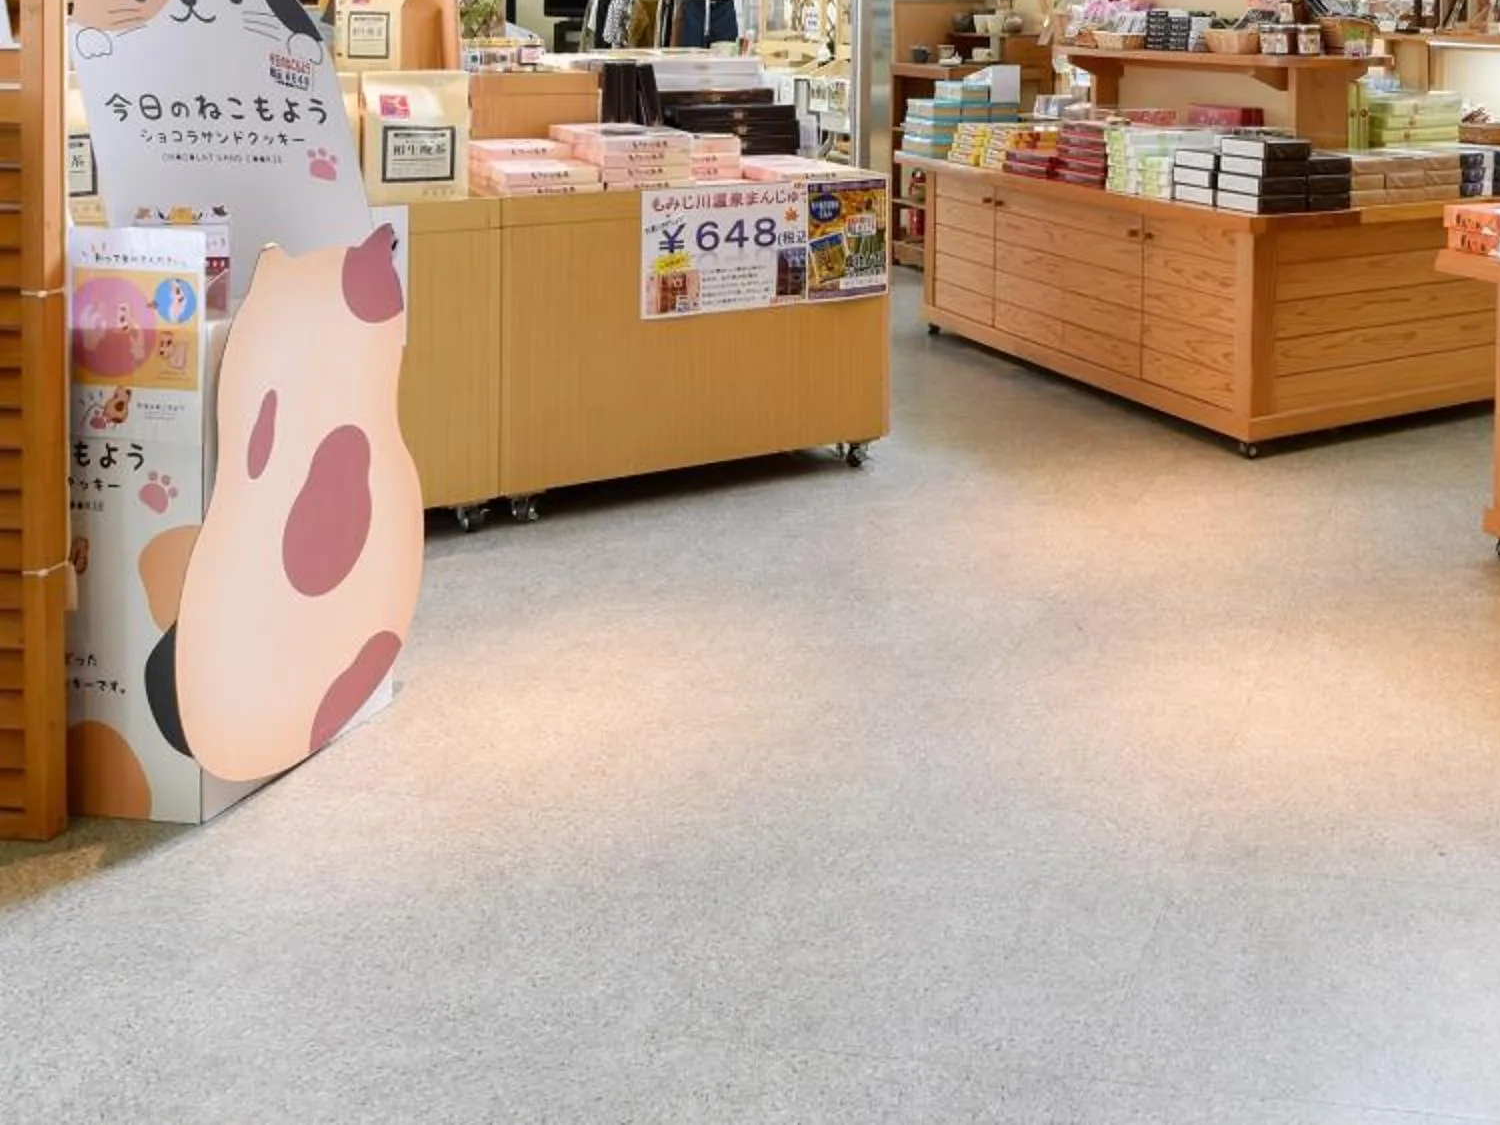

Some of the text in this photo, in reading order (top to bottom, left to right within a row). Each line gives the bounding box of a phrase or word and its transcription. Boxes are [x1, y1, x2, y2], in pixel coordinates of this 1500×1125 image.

[105, 92, 328, 125] 今日のねこもよう
[140, 129, 306, 145] ショコラサンドクッキー
[74, 443, 145, 470] もよう
